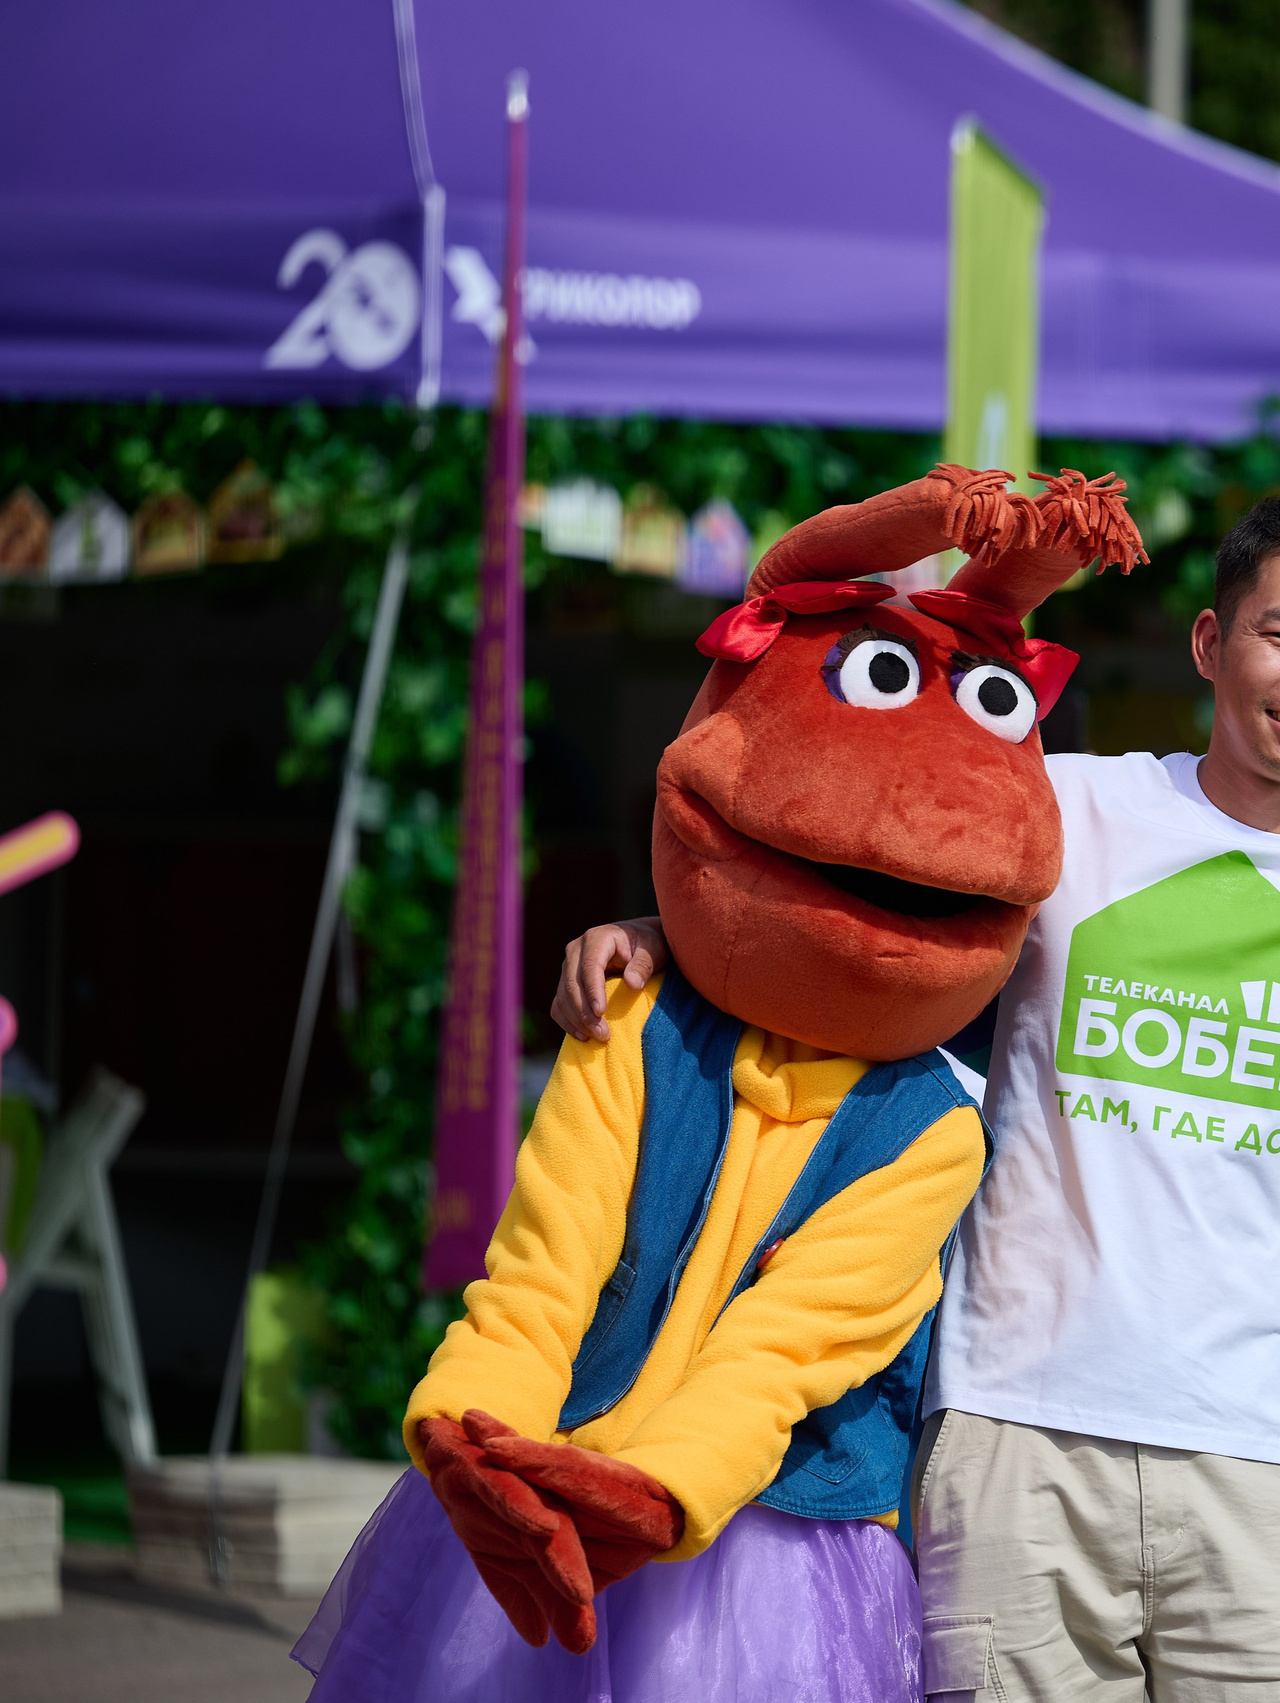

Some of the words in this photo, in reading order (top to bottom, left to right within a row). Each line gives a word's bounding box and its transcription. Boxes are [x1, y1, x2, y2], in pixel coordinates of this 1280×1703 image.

[264, 228, 421, 371] 20
[514, 266, 702, 332] РИКОЛОР
[1083, 974, 1230, 1016] ТЕЛЕКАНАЛ
[1054, 1090, 1138, 1134] ТАМ,
[1152, 1105, 1226, 1143] ГДЕ
